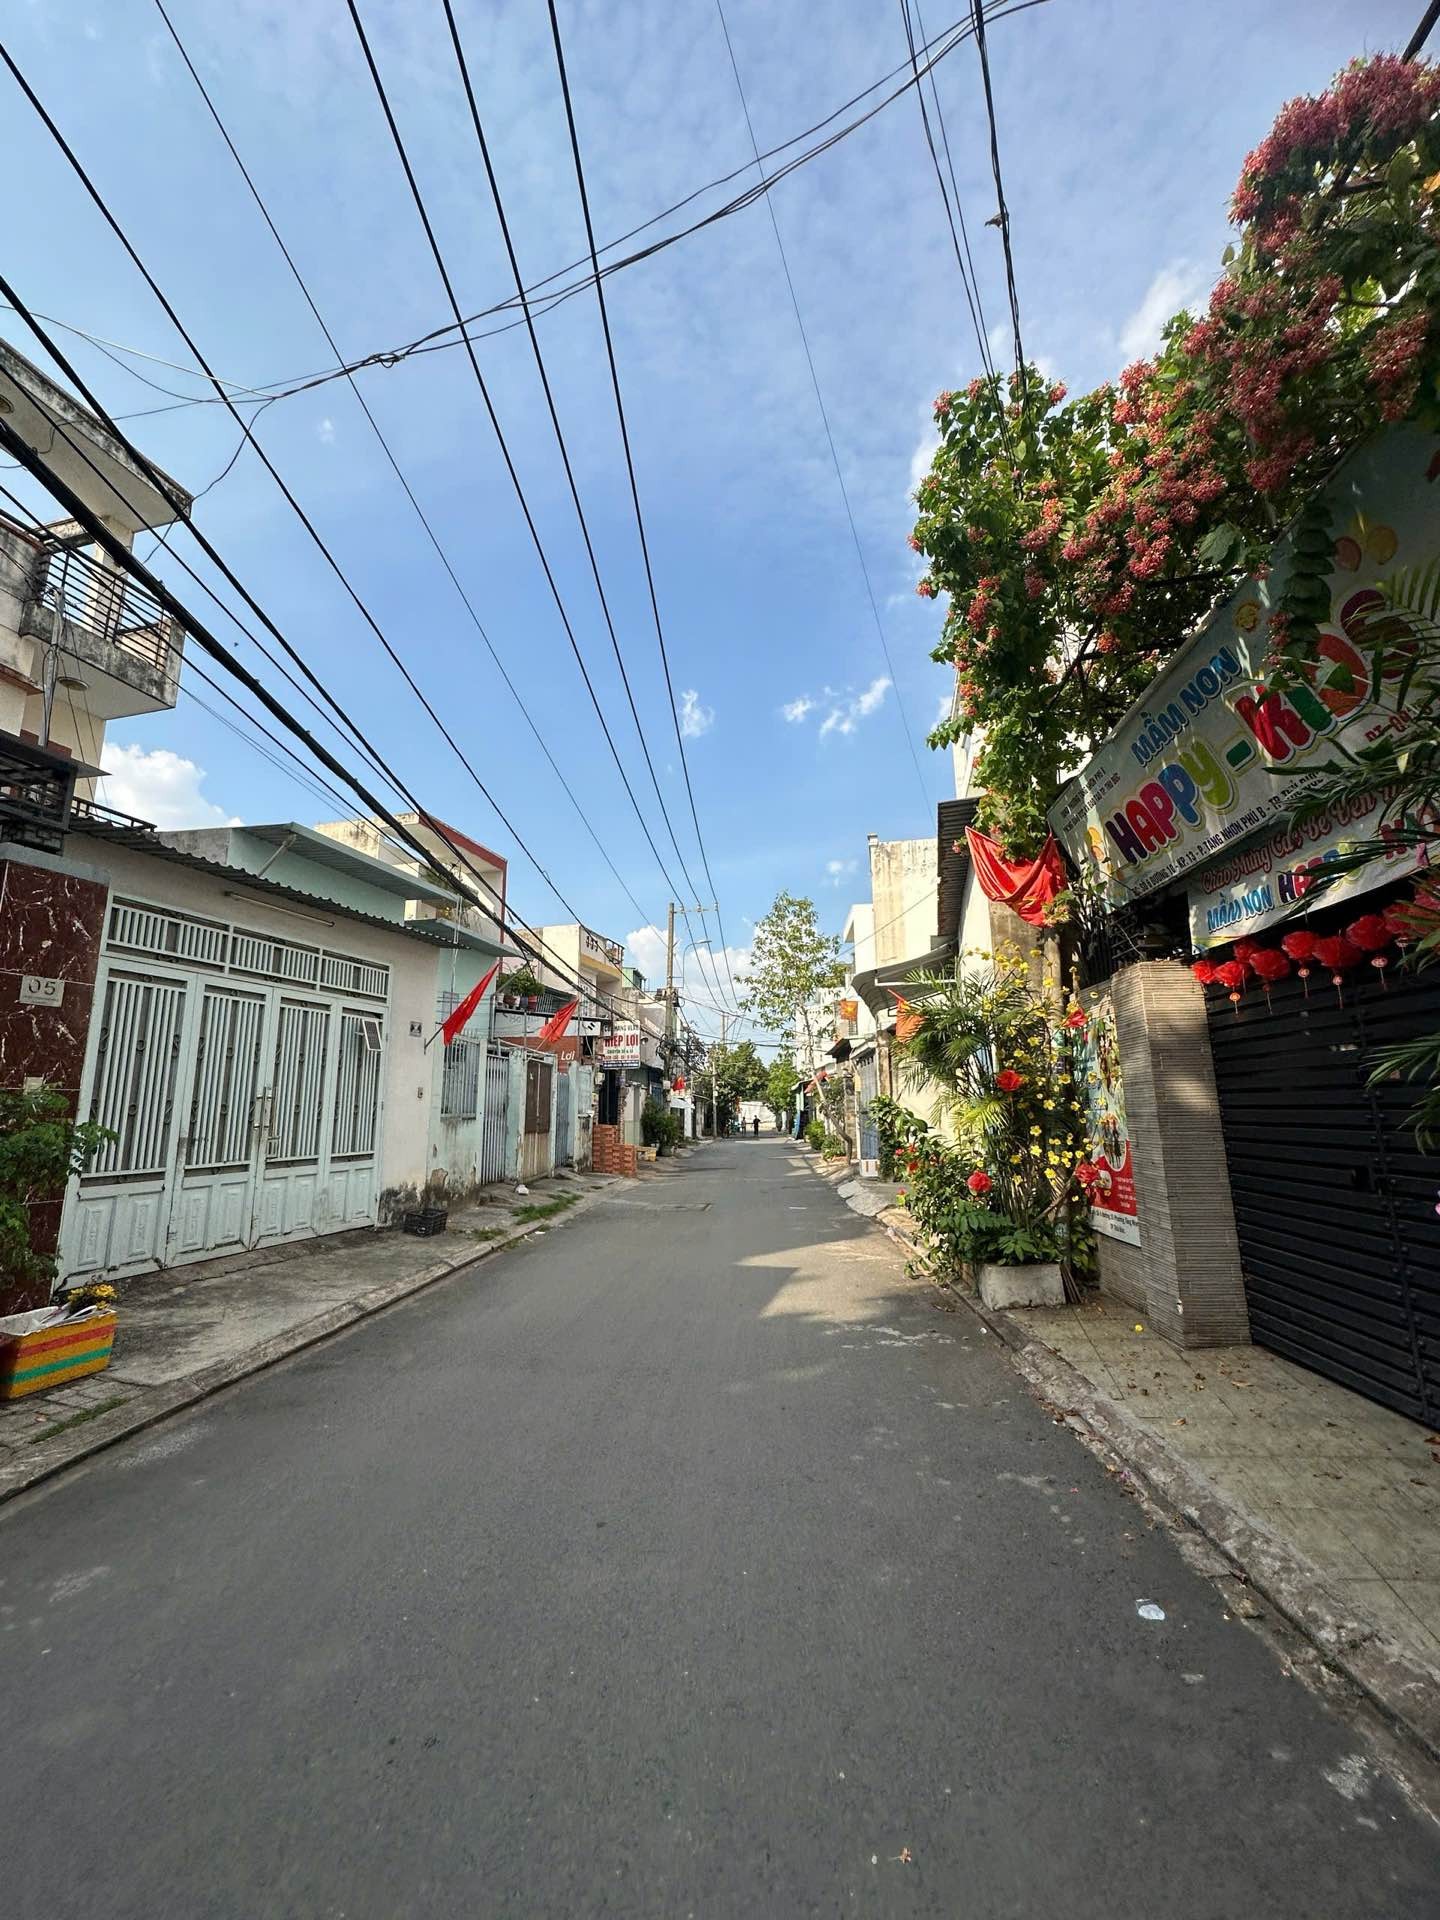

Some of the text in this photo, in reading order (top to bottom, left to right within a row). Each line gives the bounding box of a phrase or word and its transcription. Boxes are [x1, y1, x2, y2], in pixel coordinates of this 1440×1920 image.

[1130, 645, 1242, 767] MẦM NON
[1257, 805, 1267, 820] B
[1207, 883, 1275, 934] MẦM NON
[28, 979, 56, 996] 05
